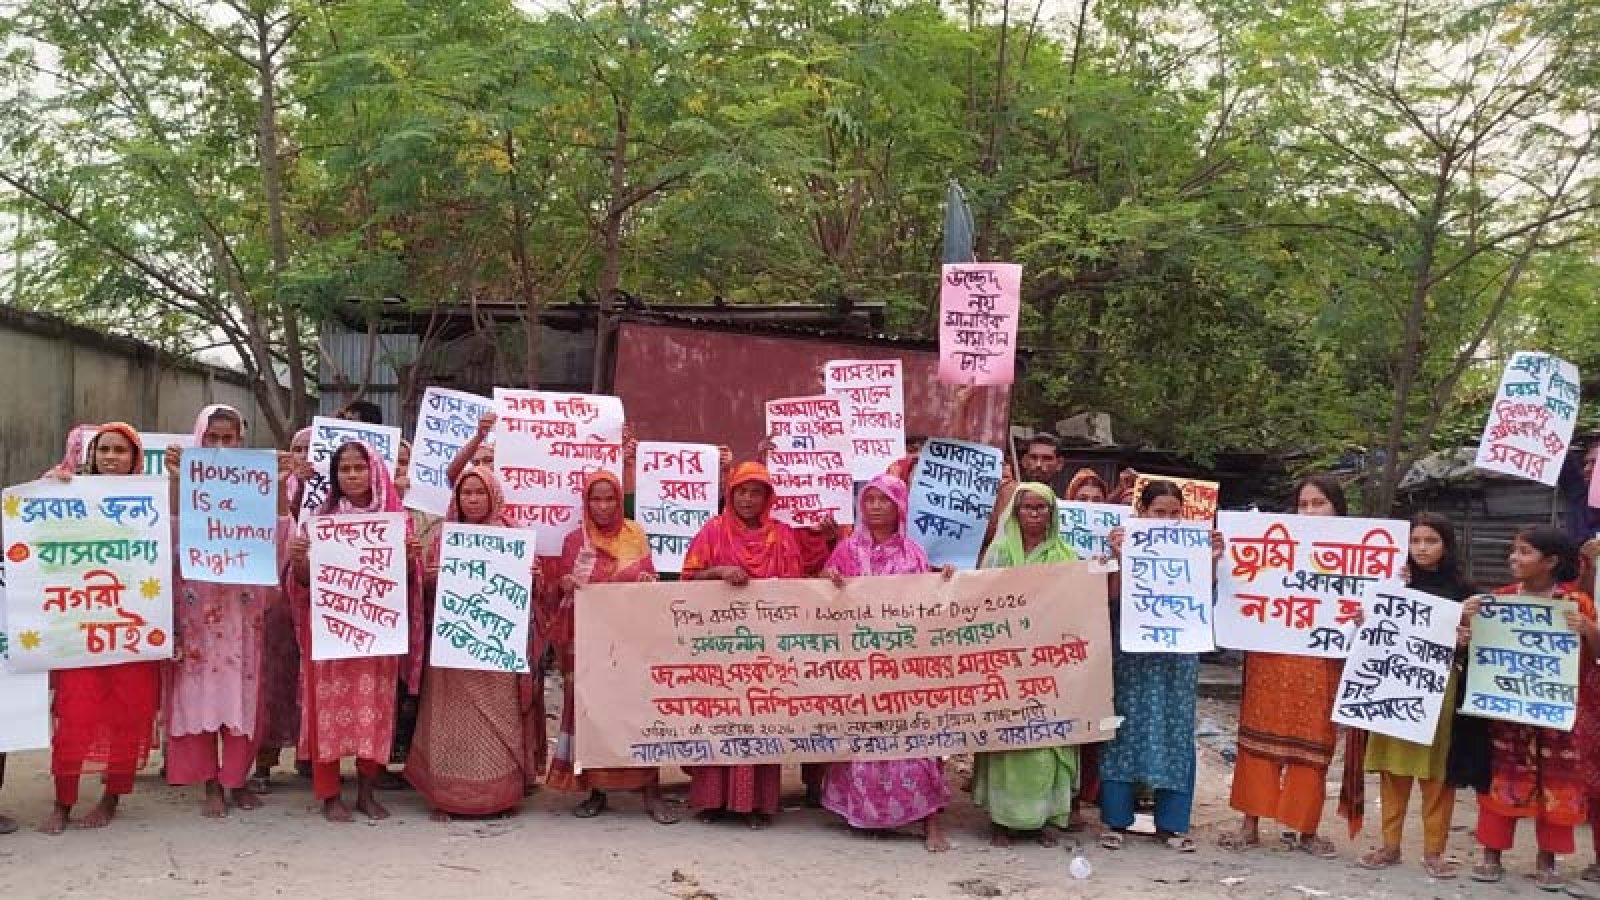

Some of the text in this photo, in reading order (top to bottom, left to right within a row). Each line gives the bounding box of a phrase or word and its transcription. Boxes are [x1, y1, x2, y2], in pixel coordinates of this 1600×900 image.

[967, 294, 1001, 315] নয়
[944, 309, 1011, 329] মানবিক
[953, 329, 1009, 347] সমাধান
[951, 347, 1005, 375] চাই
[502, 396, 545, 414] নগর
[769, 400, 841, 420] আমাদের
[501, 418, 577, 440] মানুষের
[791, 436, 815, 449] না
[642, 450, 706, 475] নগর
[771, 451, 844, 470] আমাদের
[189, 459, 273, 496] Housing
[500, 467, 563, 490] সুযোগ
[657, 480, 713, 502] সবার
[21, 496, 160, 526] সবার জন্য
[217, 496, 239, 512] a
[914, 512, 972, 540] করুন
[36, 539, 159, 567] বাসযোগ্য
[445, 531, 527, 560] বাসযোগ্য
[1229, 523, 1399, 582] তুমি আমি
[188, 546, 250, 576] Right
[441, 557, 491, 580] নগর
[1128, 555, 1191, 586] ছাড়া
[43, 569, 126, 613] নগরী
[317, 564, 399, 598] মানবিক
[315, 588, 401, 630] সমাধানে
[709, 601, 751, 624] বসতি
[815, 604, 873, 621] World
[881, 601, 945, 620] Habitat
[949, 600, 979, 623] Day
[1130, 584, 1208, 625] উচ্ছেদ
[1233, 593, 1321, 627] নগর
[1373, 593, 1433, 628] নগর
[1479, 595, 1554, 626] উন্নয়ন
[79, 608, 147, 653] চাই
[775, 633, 841, 653] বাসস্থান
[1140, 625, 1185, 650] নয়
[1510, 629, 1578, 655] হোক
[651, 663, 734, 690] জলবায়ু
[803, 658, 866, 681] নগরের
[901, 655, 954, 680] আয়ের
[957, 647, 1028, 675] মানুষের
[1475, 646, 1562, 676] মানুষের
[650, 697, 743, 718] আবাসন
[746, 687, 869, 718] নিশ্চিতকরণে
[1016, 674, 1060, 699] সভা
[1342, 669, 1382, 702] চাই
[1337, 695, 1426, 723] আমাদের
